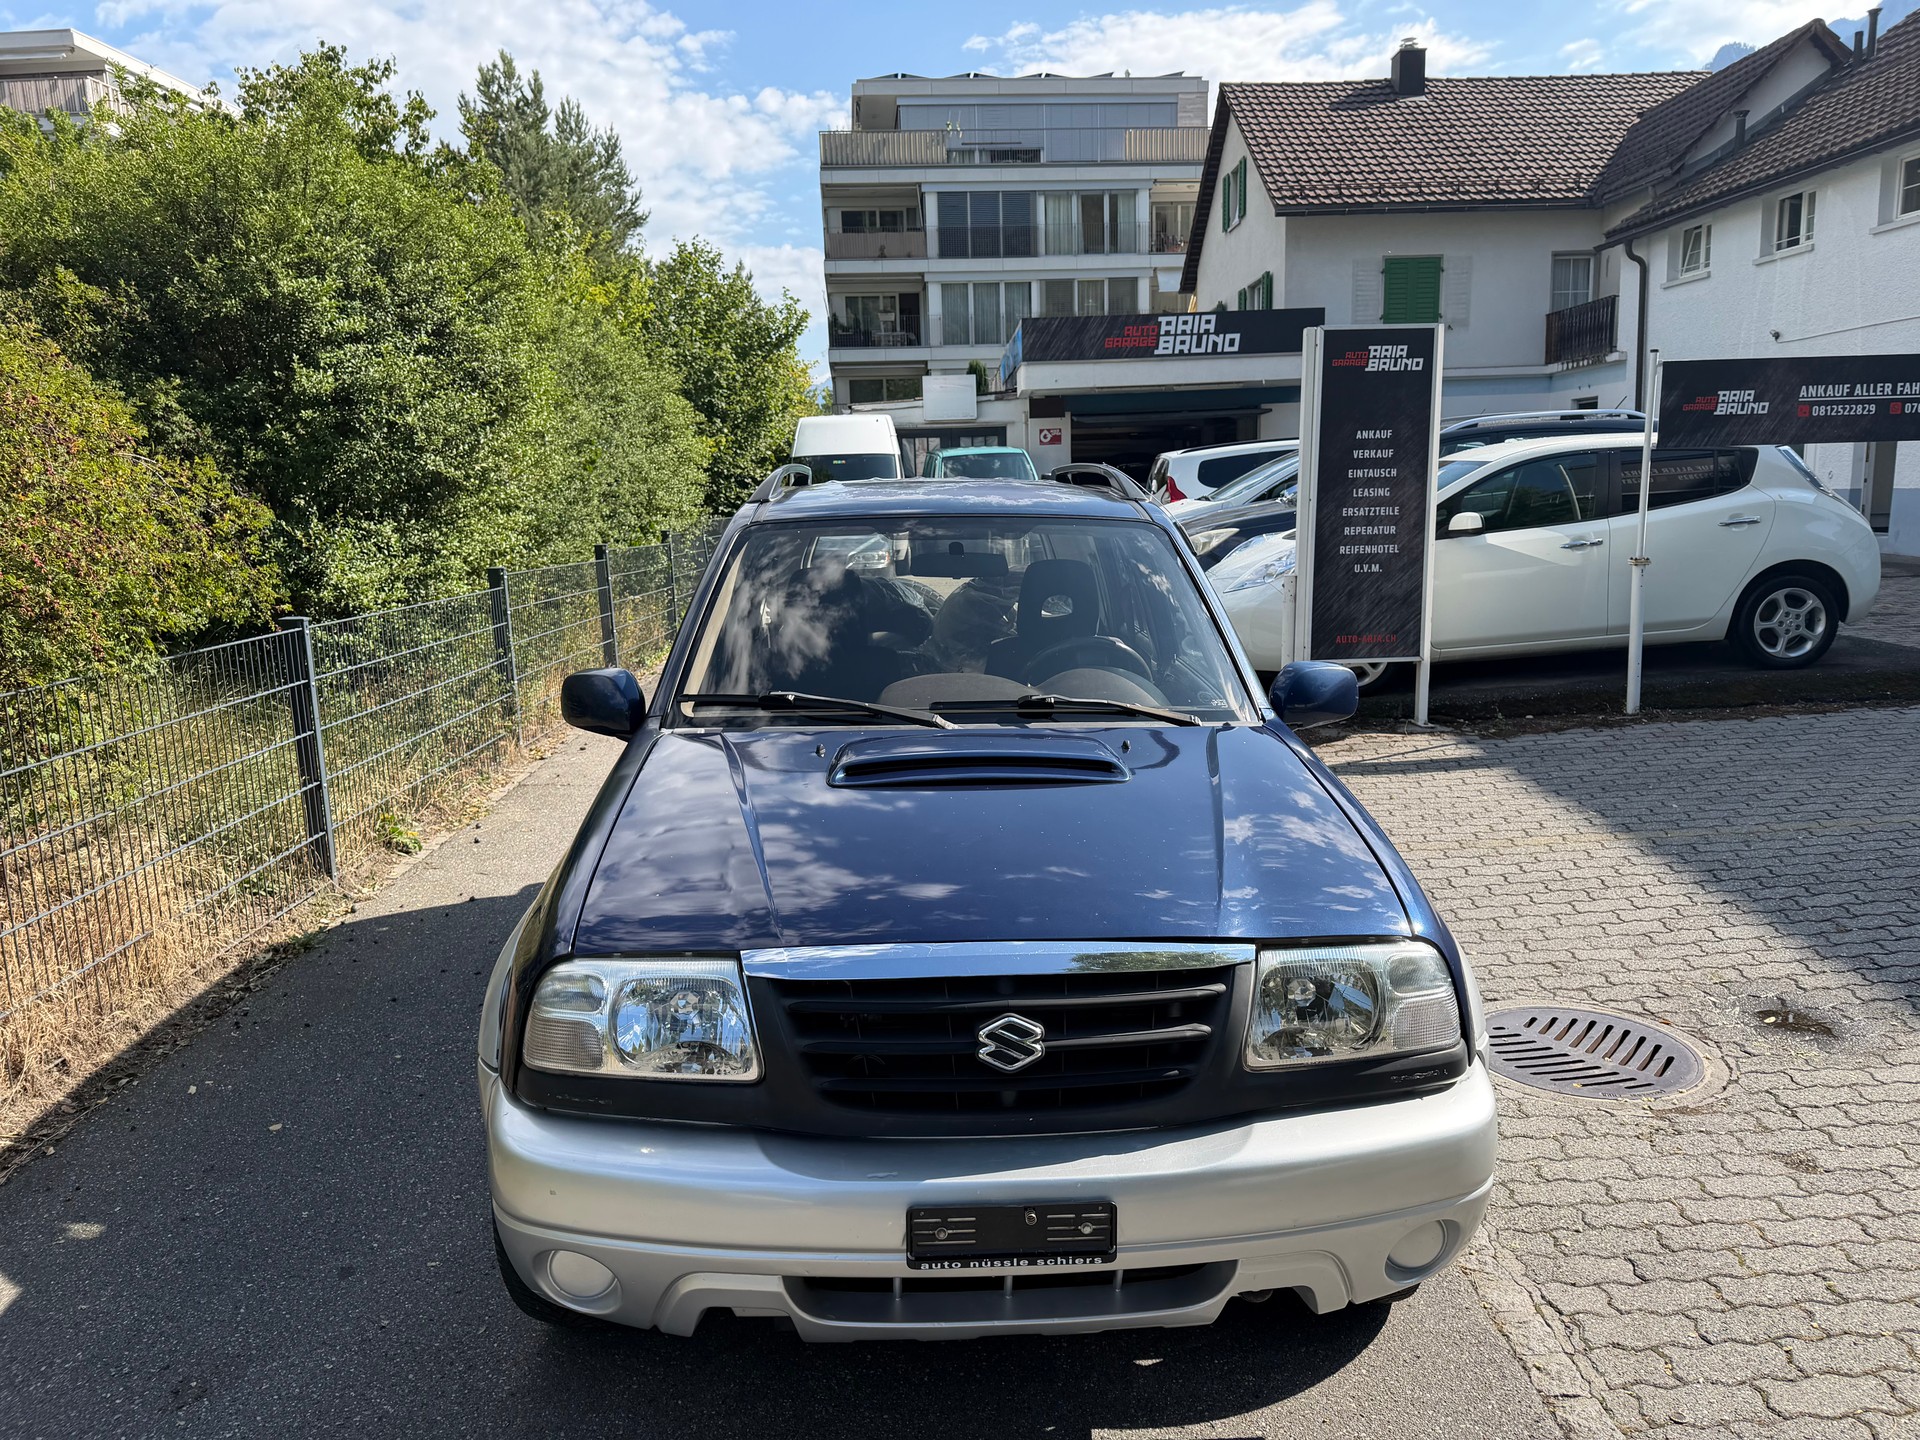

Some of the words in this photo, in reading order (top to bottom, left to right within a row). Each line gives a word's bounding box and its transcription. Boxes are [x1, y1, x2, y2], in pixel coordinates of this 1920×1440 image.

[1124, 325, 1159, 337] AUTO
[1158, 314, 1216, 335] ARIA
[1104, 337, 1157, 348] GARAGE
[1154, 332, 1241, 355] BRUNO
[1345, 351, 1369, 359] AUTO
[1368, 345, 1408, 359] ARIA
[1332, 359, 1368, 367] GARAGE
[1364, 358, 1424, 372] BRUNO
[1695, 396, 1718, 404] AUTO
[1717, 389, 1755, 403] ARIA
[1799, 384, 1851, 398] ANKAUF
[1854, 383, 1893, 397] ALLER
[1682, 403, 1717, 411] GARAGE
[1713, 402, 1770, 415] BRUNO
[1812, 404, 1876, 416] 0812522829
[1356, 430, 1392, 440] ANKAUF
[1353, 449, 1394, 459] VERKAUF
[1348, 468, 1397, 478] EINTAUSCH
[1353, 488, 1390, 497] LEASING
[1342, 507, 1399, 517] ERSATZTEILE
[1344, 526, 1396, 536] REPERATUR
[1340, 545, 1399, 555] REIFENHOTEL
[1354, 564, 1382, 573] U.V.M.
[920, 1261, 961, 1270] auto
[970, 1258, 1029, 1268] nüssle
[1036, 1256, 1102, 1266] schiers
